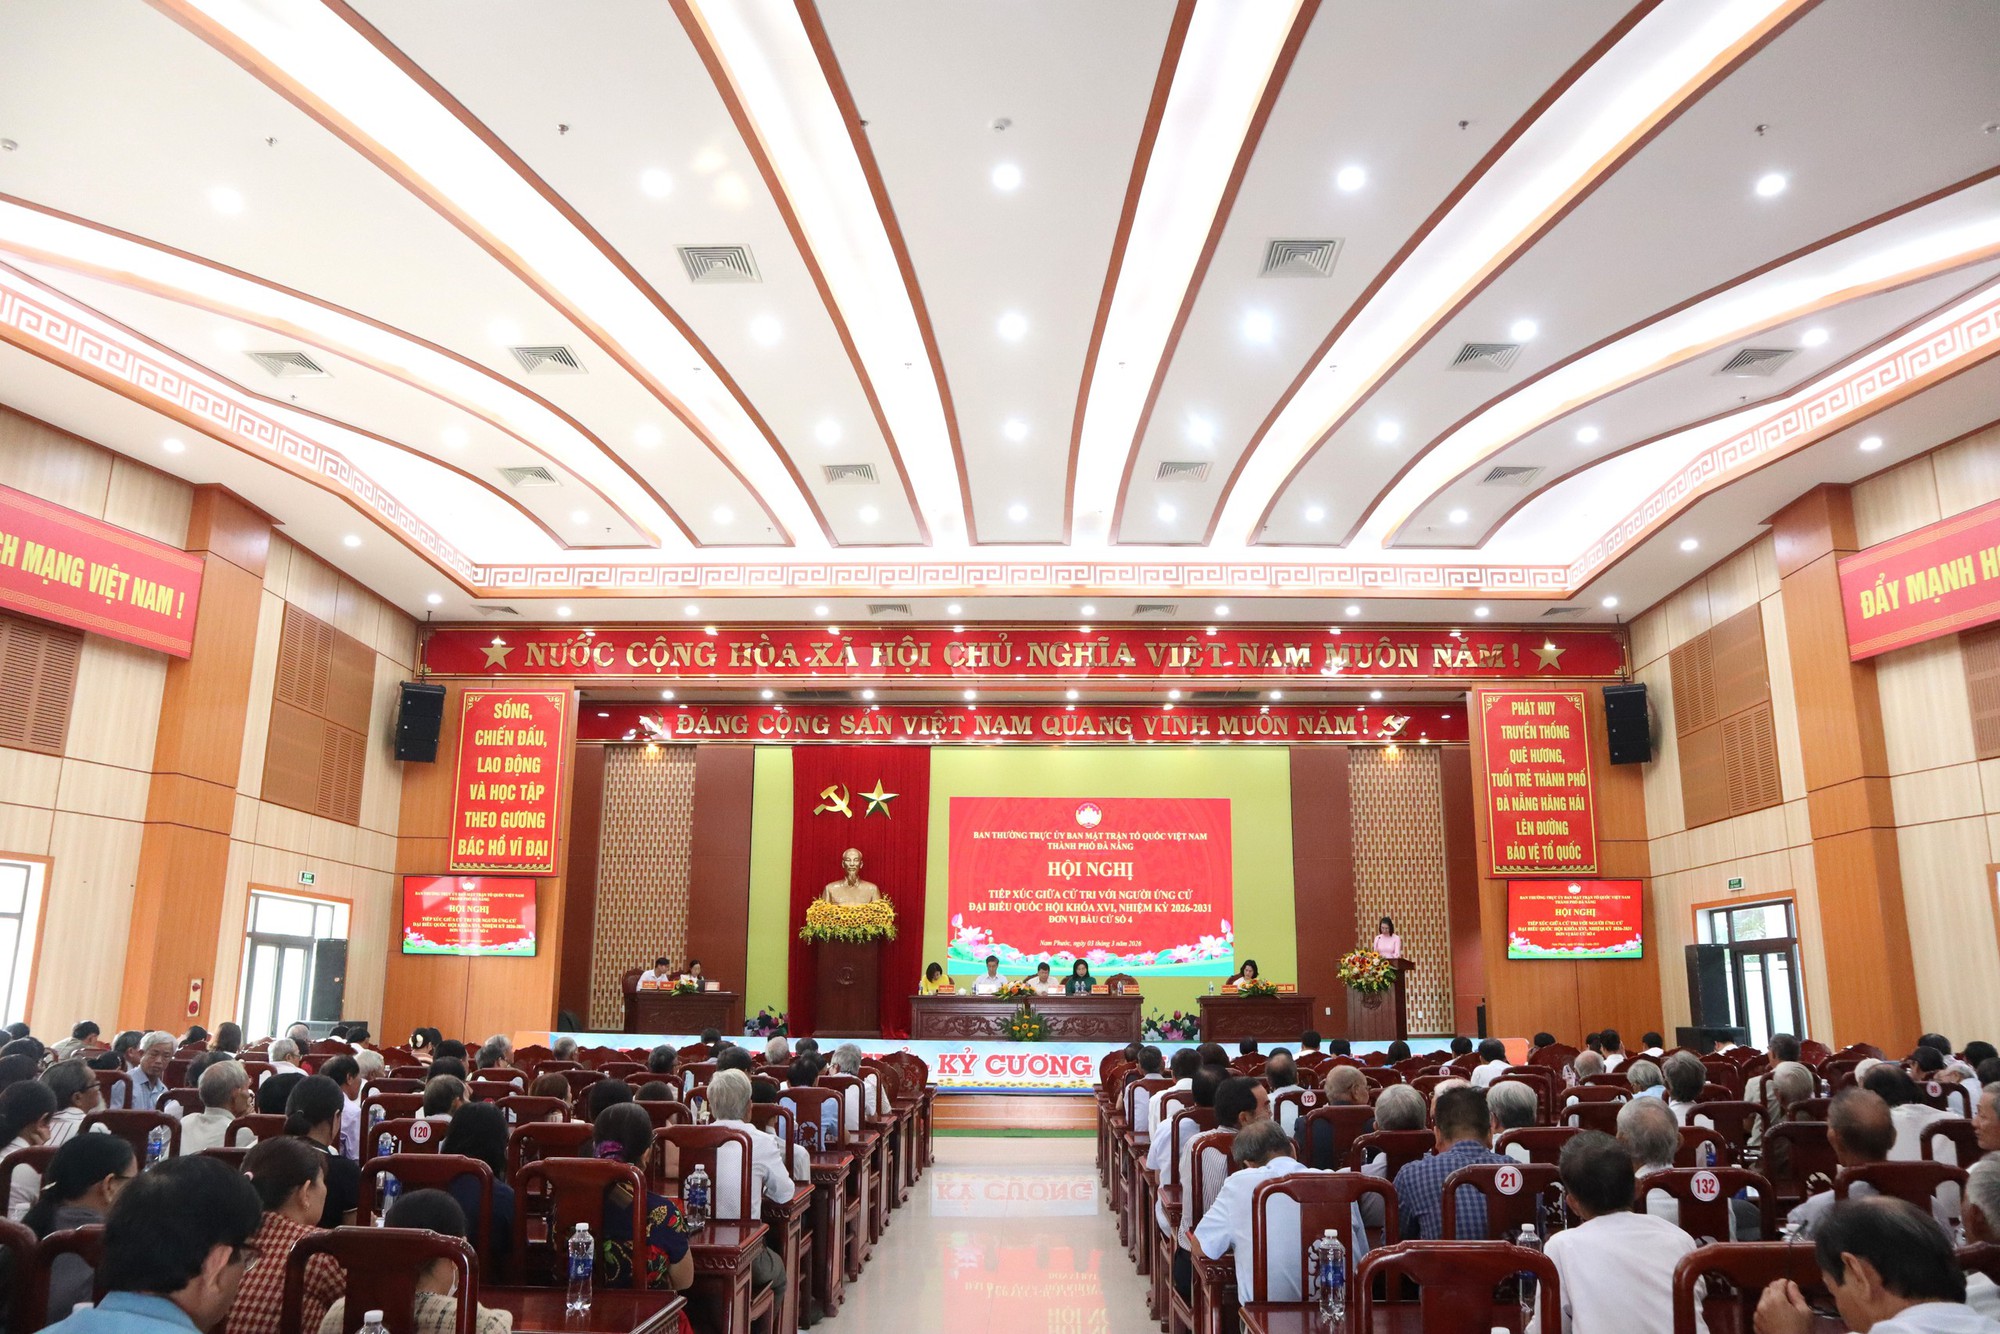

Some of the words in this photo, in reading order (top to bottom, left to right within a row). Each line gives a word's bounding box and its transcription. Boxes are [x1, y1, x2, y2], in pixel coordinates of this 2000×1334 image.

[21, 540, 85, 588] MẠNG
[89, 563, 130, 605] VIỆT
[130, 577, 174, 616] NAM
[1860, 572, 1900, 619] ĐẨY
[1905, 554, 1976, 604] MẠNH
[1979, 545, 2000, 581] H
[525, 634, 615, 669] NƯỚC
[626, 636, 718, 674] CỘNG
[728, 634, 799, 669] HÒA
[808, 638, 858, 669] XÃ
[870, 636, 931, 674] HỘI
[943, 633, 1011, 669] CHỦ
[1028, 638, 1131, 669] NGHĨA
[1144, 636, 1228, 673] VIỆT
[1238, 642, 1311, 669] NAM
[1325, 636, 1420, 669] MUÔN
[493, 697, 533, 721] SỐNG,
[1511, 698, 1535, 715] PHÁT
[1538, 702, 1556, 715] HUY
[675, 709, 749, 736] ĐẢNG
[757, 708, 831, 740] CỘNG
[840, 709, 893, 736] SẢN
[902, 709, 964, 741] VIỆT
[974, 714, 1032, 736] NAM
[1041, 714, 1132, 739] QUANG
[1143, 714, 1210, 736] VINH
[1218, 708, 1294, 737] MUÔN
[1501, 721, 1537, 739] TRUYỀN
[1539, 720, 1570, 739] THỐNG
[475, 725, 514, 746] CHIẾN
[517, 725, 547, 748] ĐẤU,
[1509, 746, 1528, 764] QUÊ
[1531, 748, 1565, 764] HƯƠNG,
[477, 757, 501, 773] LAO
[504, 754, 541, 777] ĐỘNG
[1491, 767, 1512, 787] TUỔI
[1515, 768, 1532, 787] TRẺ
[1534, 769, 1564, 787] THÀNH
[1567, 768, 1586, 787] PHỐ
[469, 782, 486, 800] VÀ
[490, 784, 516, 805] HỌC
[520, 782, 545, 805] TẬP
[1496, 793, 1510, 811] ĐÀ
[1569, 793, 1585, 811] HÁI
[464, 811, 497, 828] THEO
[500, 810, 546, 828] GƯƠNG
[1516, 818, 1534, 836] LÊN
[1536, 817, 1569, 836] ĐƯỜNG
[973, 831, 990, 839] BAN
[992, 830, 1027, 839] THƯỜNG
[1029, 831, 1052, 841] TRỰC
[1053, 830, 1065, 840] ỦY
[1066, 832, 1083, 840] BAN
[1168, 832, 1187, 841] VIỆT
[1188, 832, 1207, 840] NAM
[458, 836, 485, 856] BÁC
[488, 834, 506, 856] HỒ
[509, 836, 523, 857] VĨ
[525, 840, 548, 860] ĐẠI
[1047, 841, 1076, 850] THÀNH
[1097, 841, 1108, 850] ĐÀ
[1507, 841, 1526, 860] BẢO
[1528, 842, 1540, 863] VỆ
[1541, 840, 1554, 860] TỔ
[1556, 841, 1581, 861] QUỐC
[1047, 859, 1082, 880] HỘI
[1086, 861, 1134, 881] NGHỊ
[988, 888, 1011, 899] TIẾP
[1012, 888, 1033, 899] XÚC
[1035, 889, 1061, 899] GIỮA
[1062, 888, 1078, 899] CỬ
[1079, 890, 1096, 899] TRI
[1098, 889, 1116, 899] VỚI
[1118, 889, 1151, 899] NGƯỜI
[1154, 889, 1176, 899] ỨNG
[1178, 889, 1193, 900] CỬ
[449, 905, 465, 914] HỘI
[467, 905, 489, 915] NGHỊ
[968, 902, 986, 913] ĐẠI
[1045, 902, 1064, 913] HỘI
[1066, 901, 1095, 912] KHÓA
[1097, 903, 1117, 913] XVI,
[1119, 902, 1152, 914] NHIỆM
[1171, 903, 1212, 912] 2026-2031
[1555, 907, 1572, 918] HỘI
[1573, 908, 1596, 918] NGHỊ
[1048, 915, 1067, 923] ĐƠN
[1069, 915, 1079, 925] VỊ
[1100, 914, 1114, 923] CỬ
[1127, 915, 1133, 923] 4
[937, 1046, 977, 1075] KỶ
[985, 1053, 1093, 1076] CƯƠNG
[1303, 1095, 1315, 1103] 123
[414, 1126, 428, 1137] 120
[1501, 1173, 1516, 1188] 21
[1695, 1179, 1715, 1194] 132
